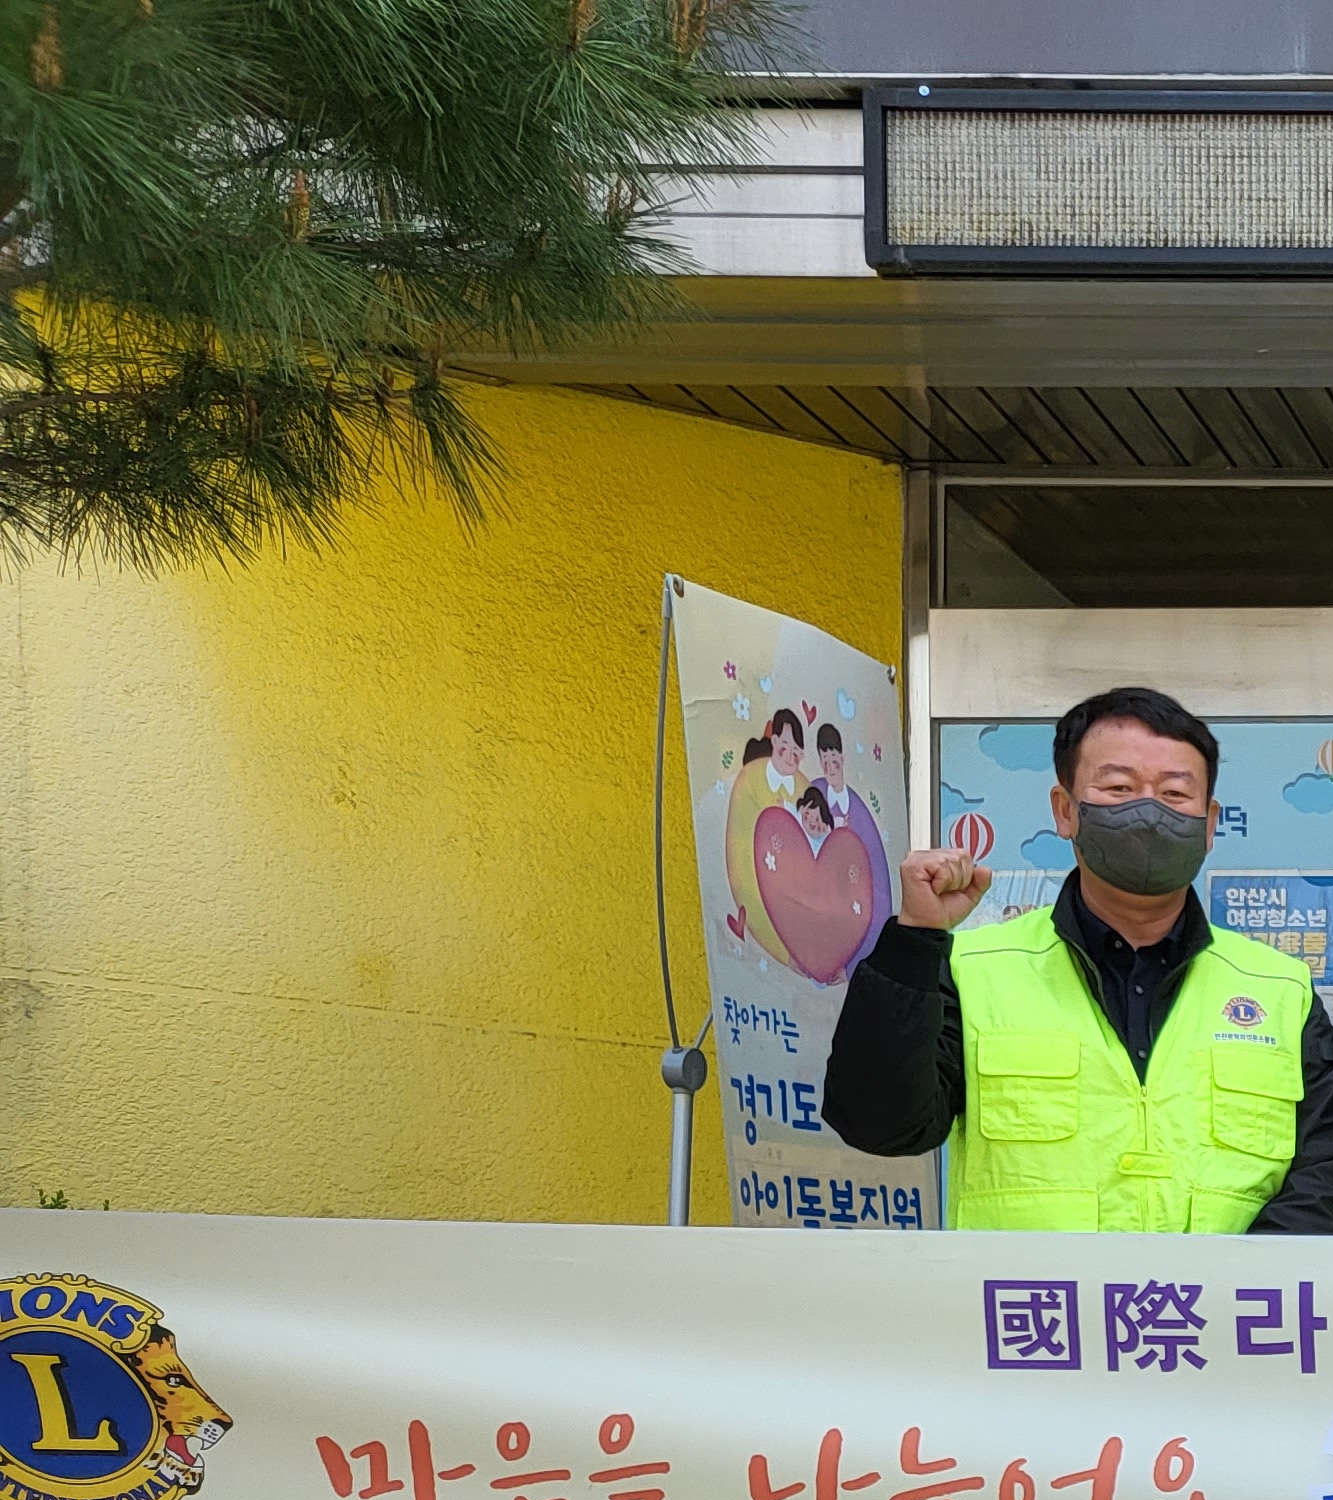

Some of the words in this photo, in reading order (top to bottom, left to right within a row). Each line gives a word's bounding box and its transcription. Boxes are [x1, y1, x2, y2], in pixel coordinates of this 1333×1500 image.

[1225, 888, 1287, 907] 안산시
[1226, 909, 1327, 927] 여성청소년
[724, 996, 800, 1054] 찾아가는
[731, 1074, 822, 1145] 경기도
[11, 1353, 120, 1451] L
